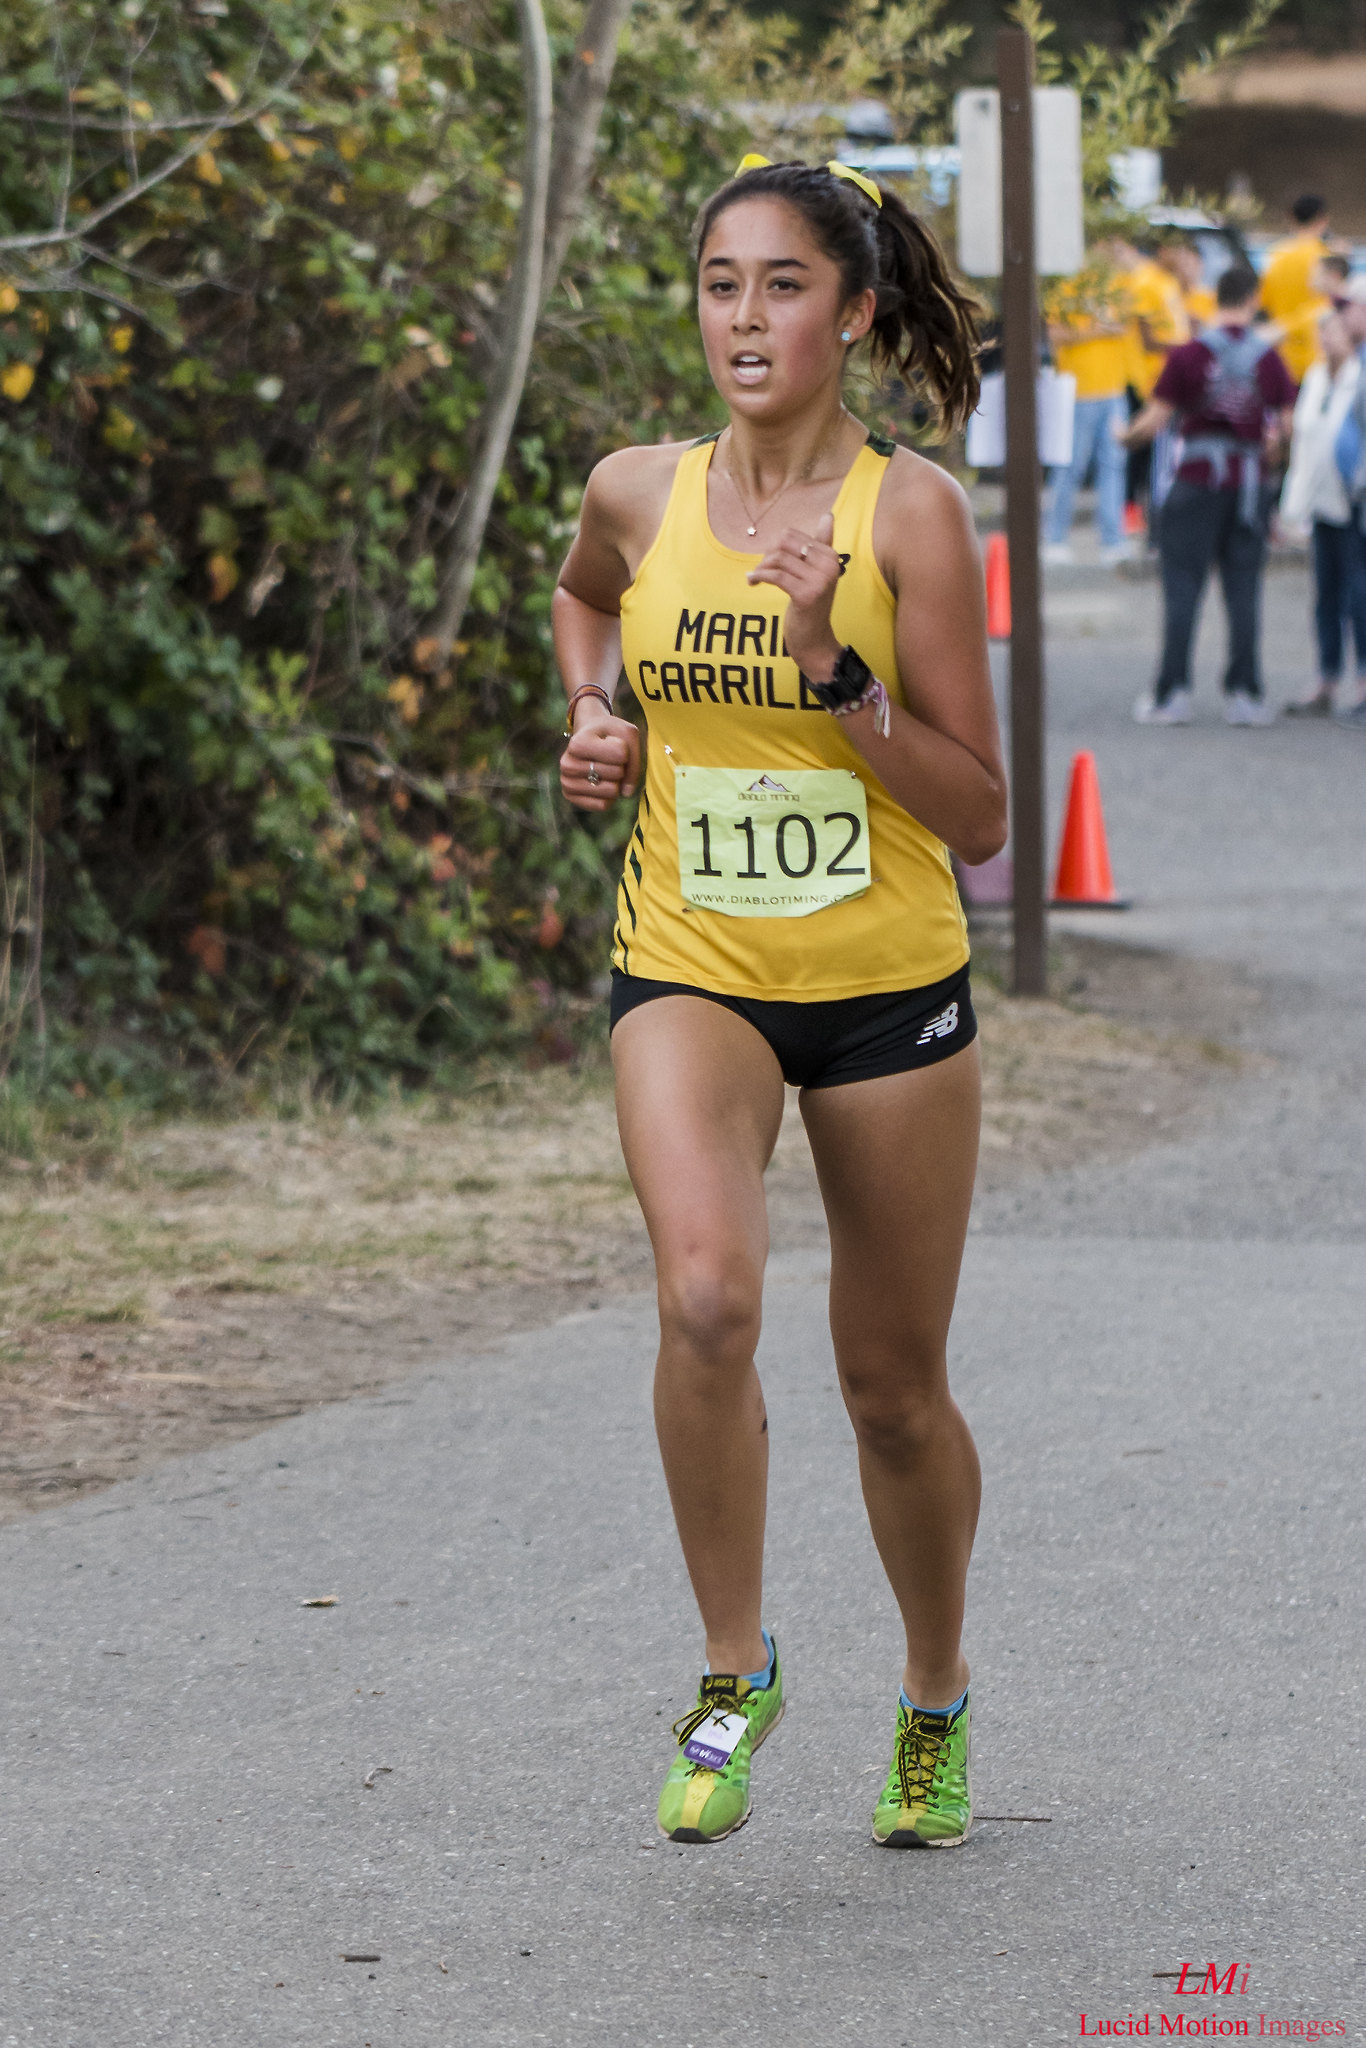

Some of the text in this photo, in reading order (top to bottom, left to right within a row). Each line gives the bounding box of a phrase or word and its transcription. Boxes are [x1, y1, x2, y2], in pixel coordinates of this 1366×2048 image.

[675, 608, 791, 657] MARI
[639, 660, 827, 711] CARRILL
[691, 811, 866, 879] 1102
[691, 893, 850, 906] WWW.DIABLOTIMING.C
